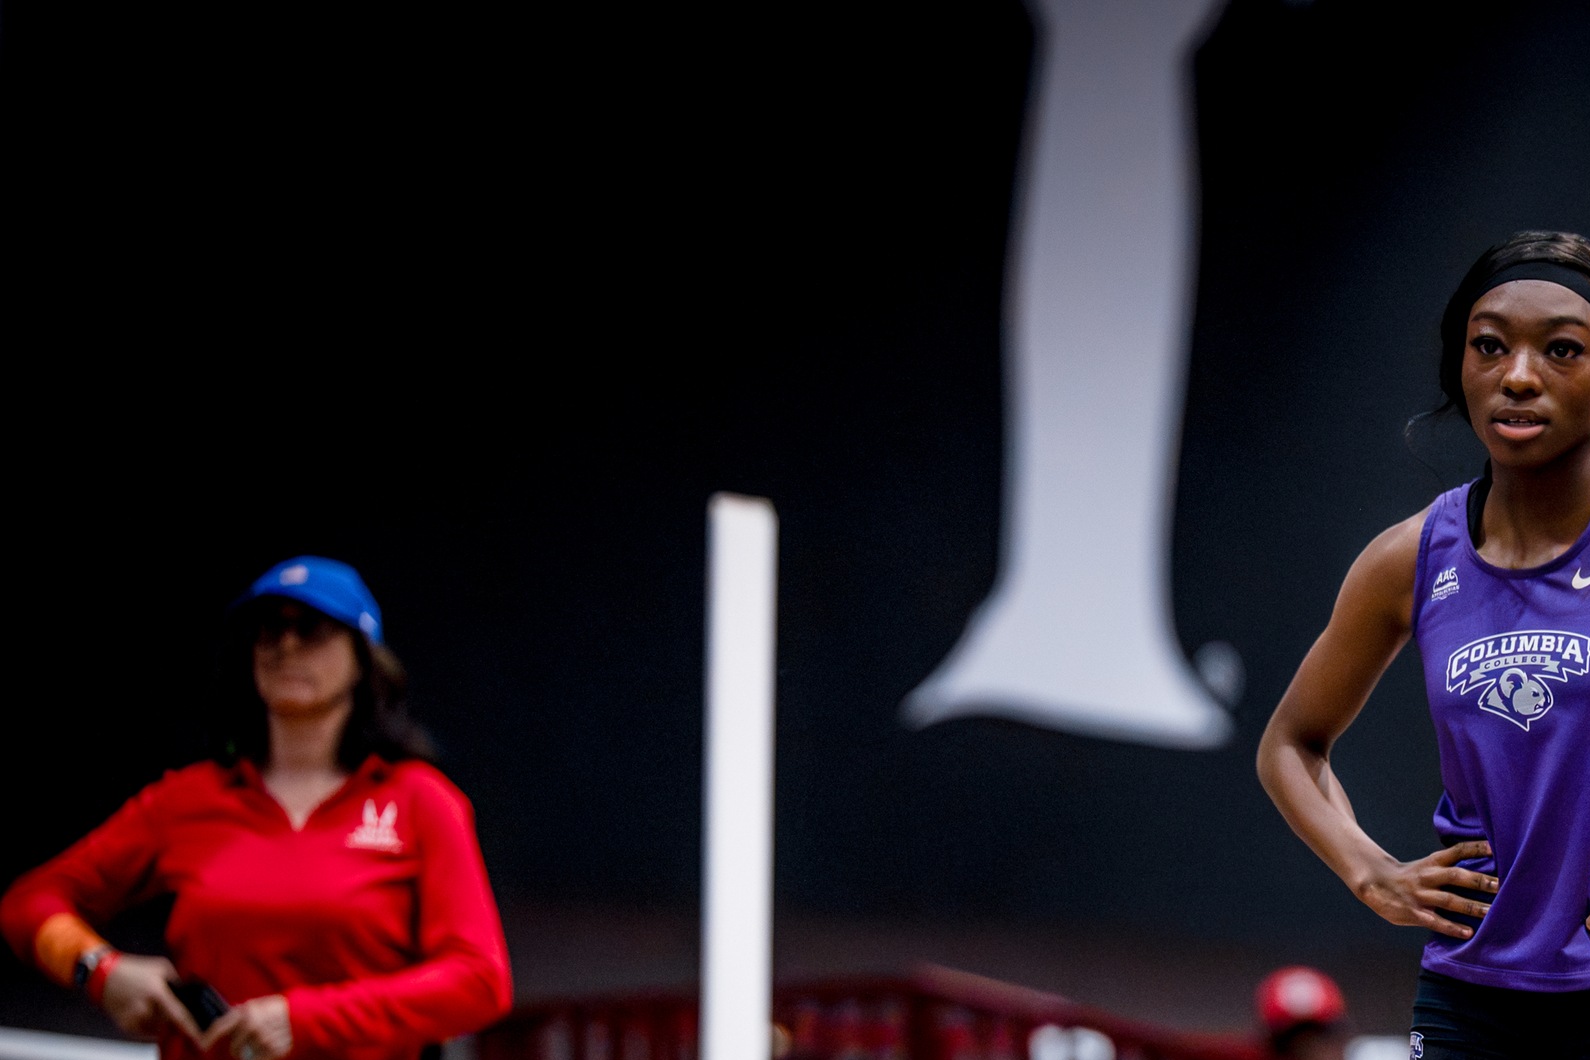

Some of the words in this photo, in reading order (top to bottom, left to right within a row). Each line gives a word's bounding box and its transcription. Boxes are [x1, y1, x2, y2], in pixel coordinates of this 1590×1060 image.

[1436, 567, 1457, 585] AAC
[1451, 635, 1584, 679] COLUMBIA
[1484, 655, 1547, 669] COLLEGE
